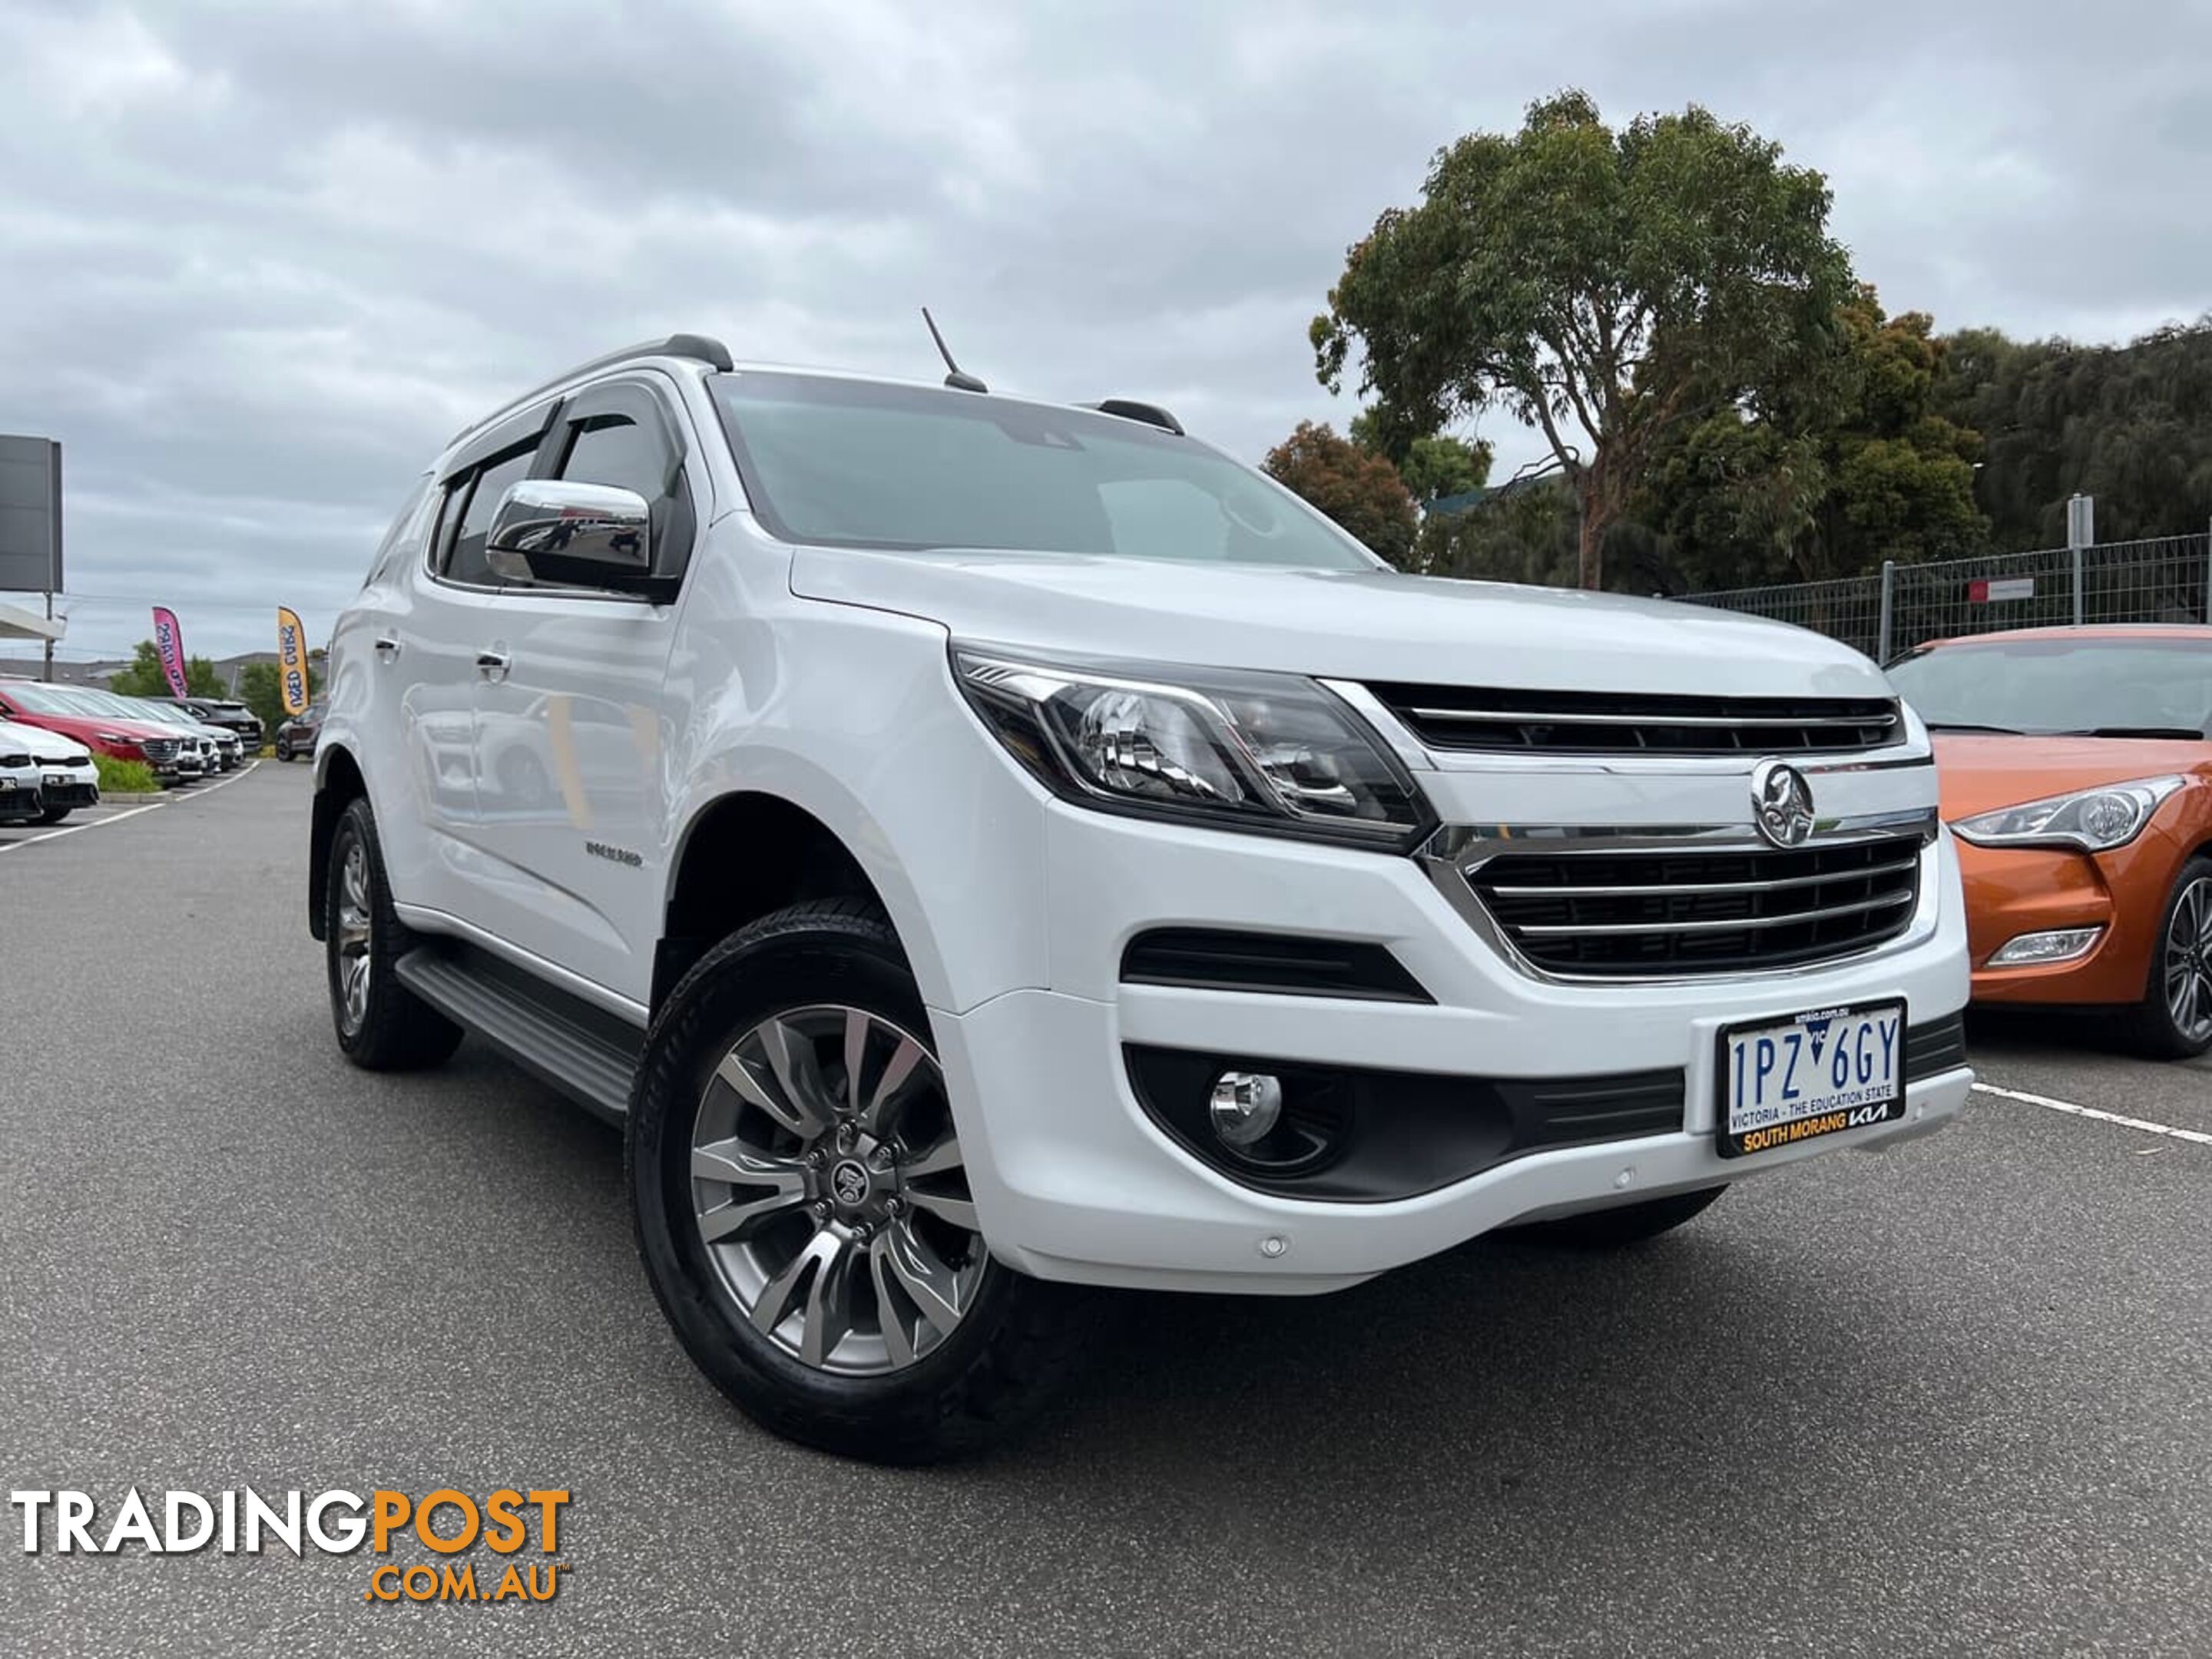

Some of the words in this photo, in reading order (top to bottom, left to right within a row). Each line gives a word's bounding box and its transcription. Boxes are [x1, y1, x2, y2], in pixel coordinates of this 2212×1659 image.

[1734, 1033, 1802, 1108] 1PZ
[1833, 1018, 1897, 1089] 6GY
[1731, 1107, 1780, 1129] VICTORIA
[1790, 1101, 1809, 1118] THE
[1810, 1091, 1862, 1113] EDUCATION
[1865, 1084, 1892, 1101] STATE
[1743, 1127, 1788, 1151] SOUTH
[1790, 1112, 1846, 1139] MORANG
